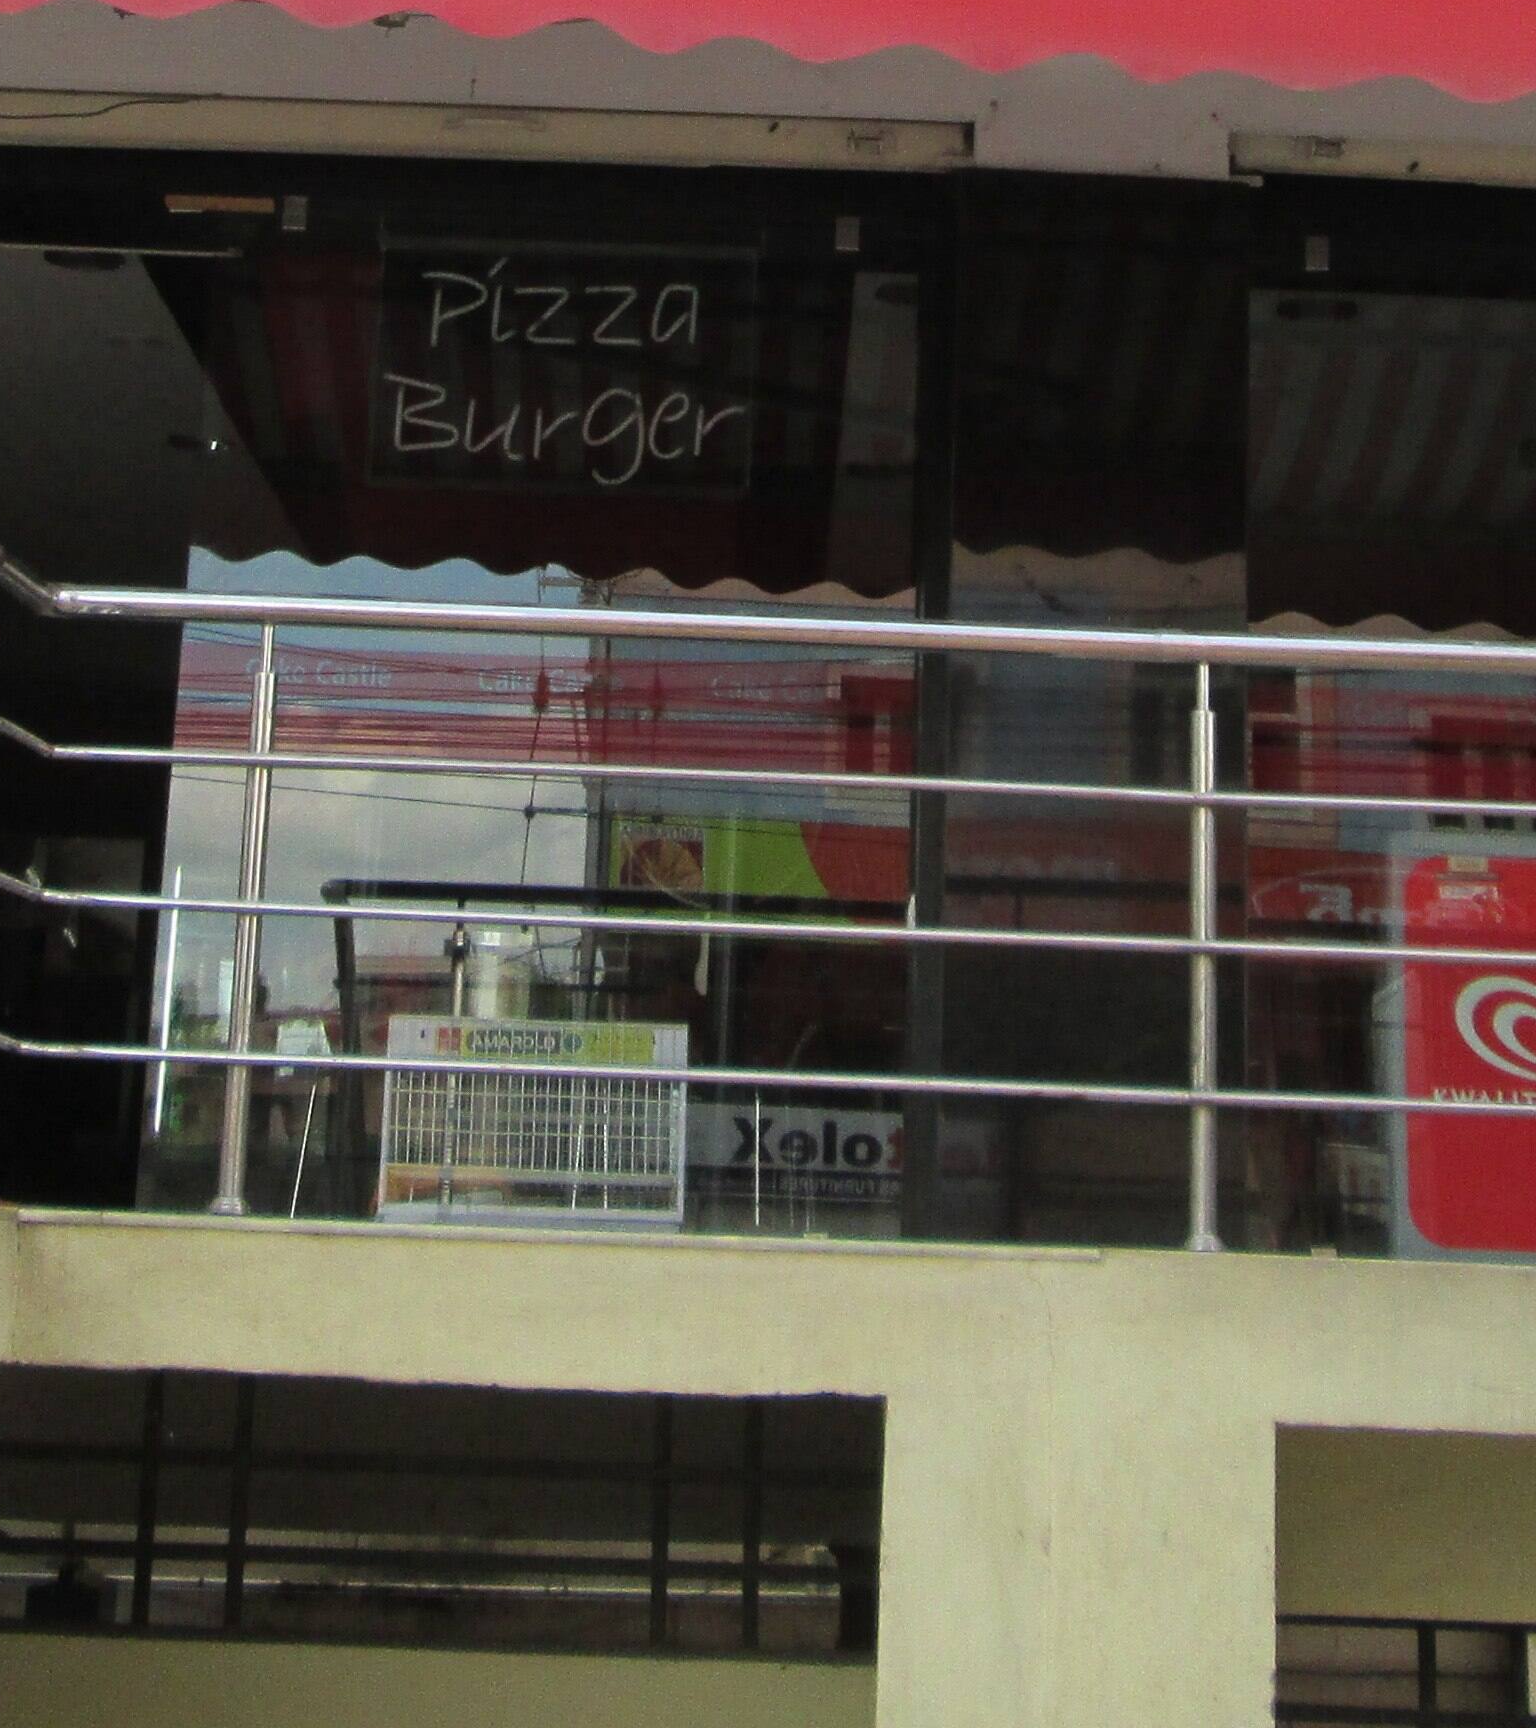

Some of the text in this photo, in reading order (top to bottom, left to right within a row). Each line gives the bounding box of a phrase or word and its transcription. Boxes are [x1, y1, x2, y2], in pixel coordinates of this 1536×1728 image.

[420, 256, 701, 348] Pizza
[383, 371, 747, 486] Burger
[245, 657, 305, 684] Cke
